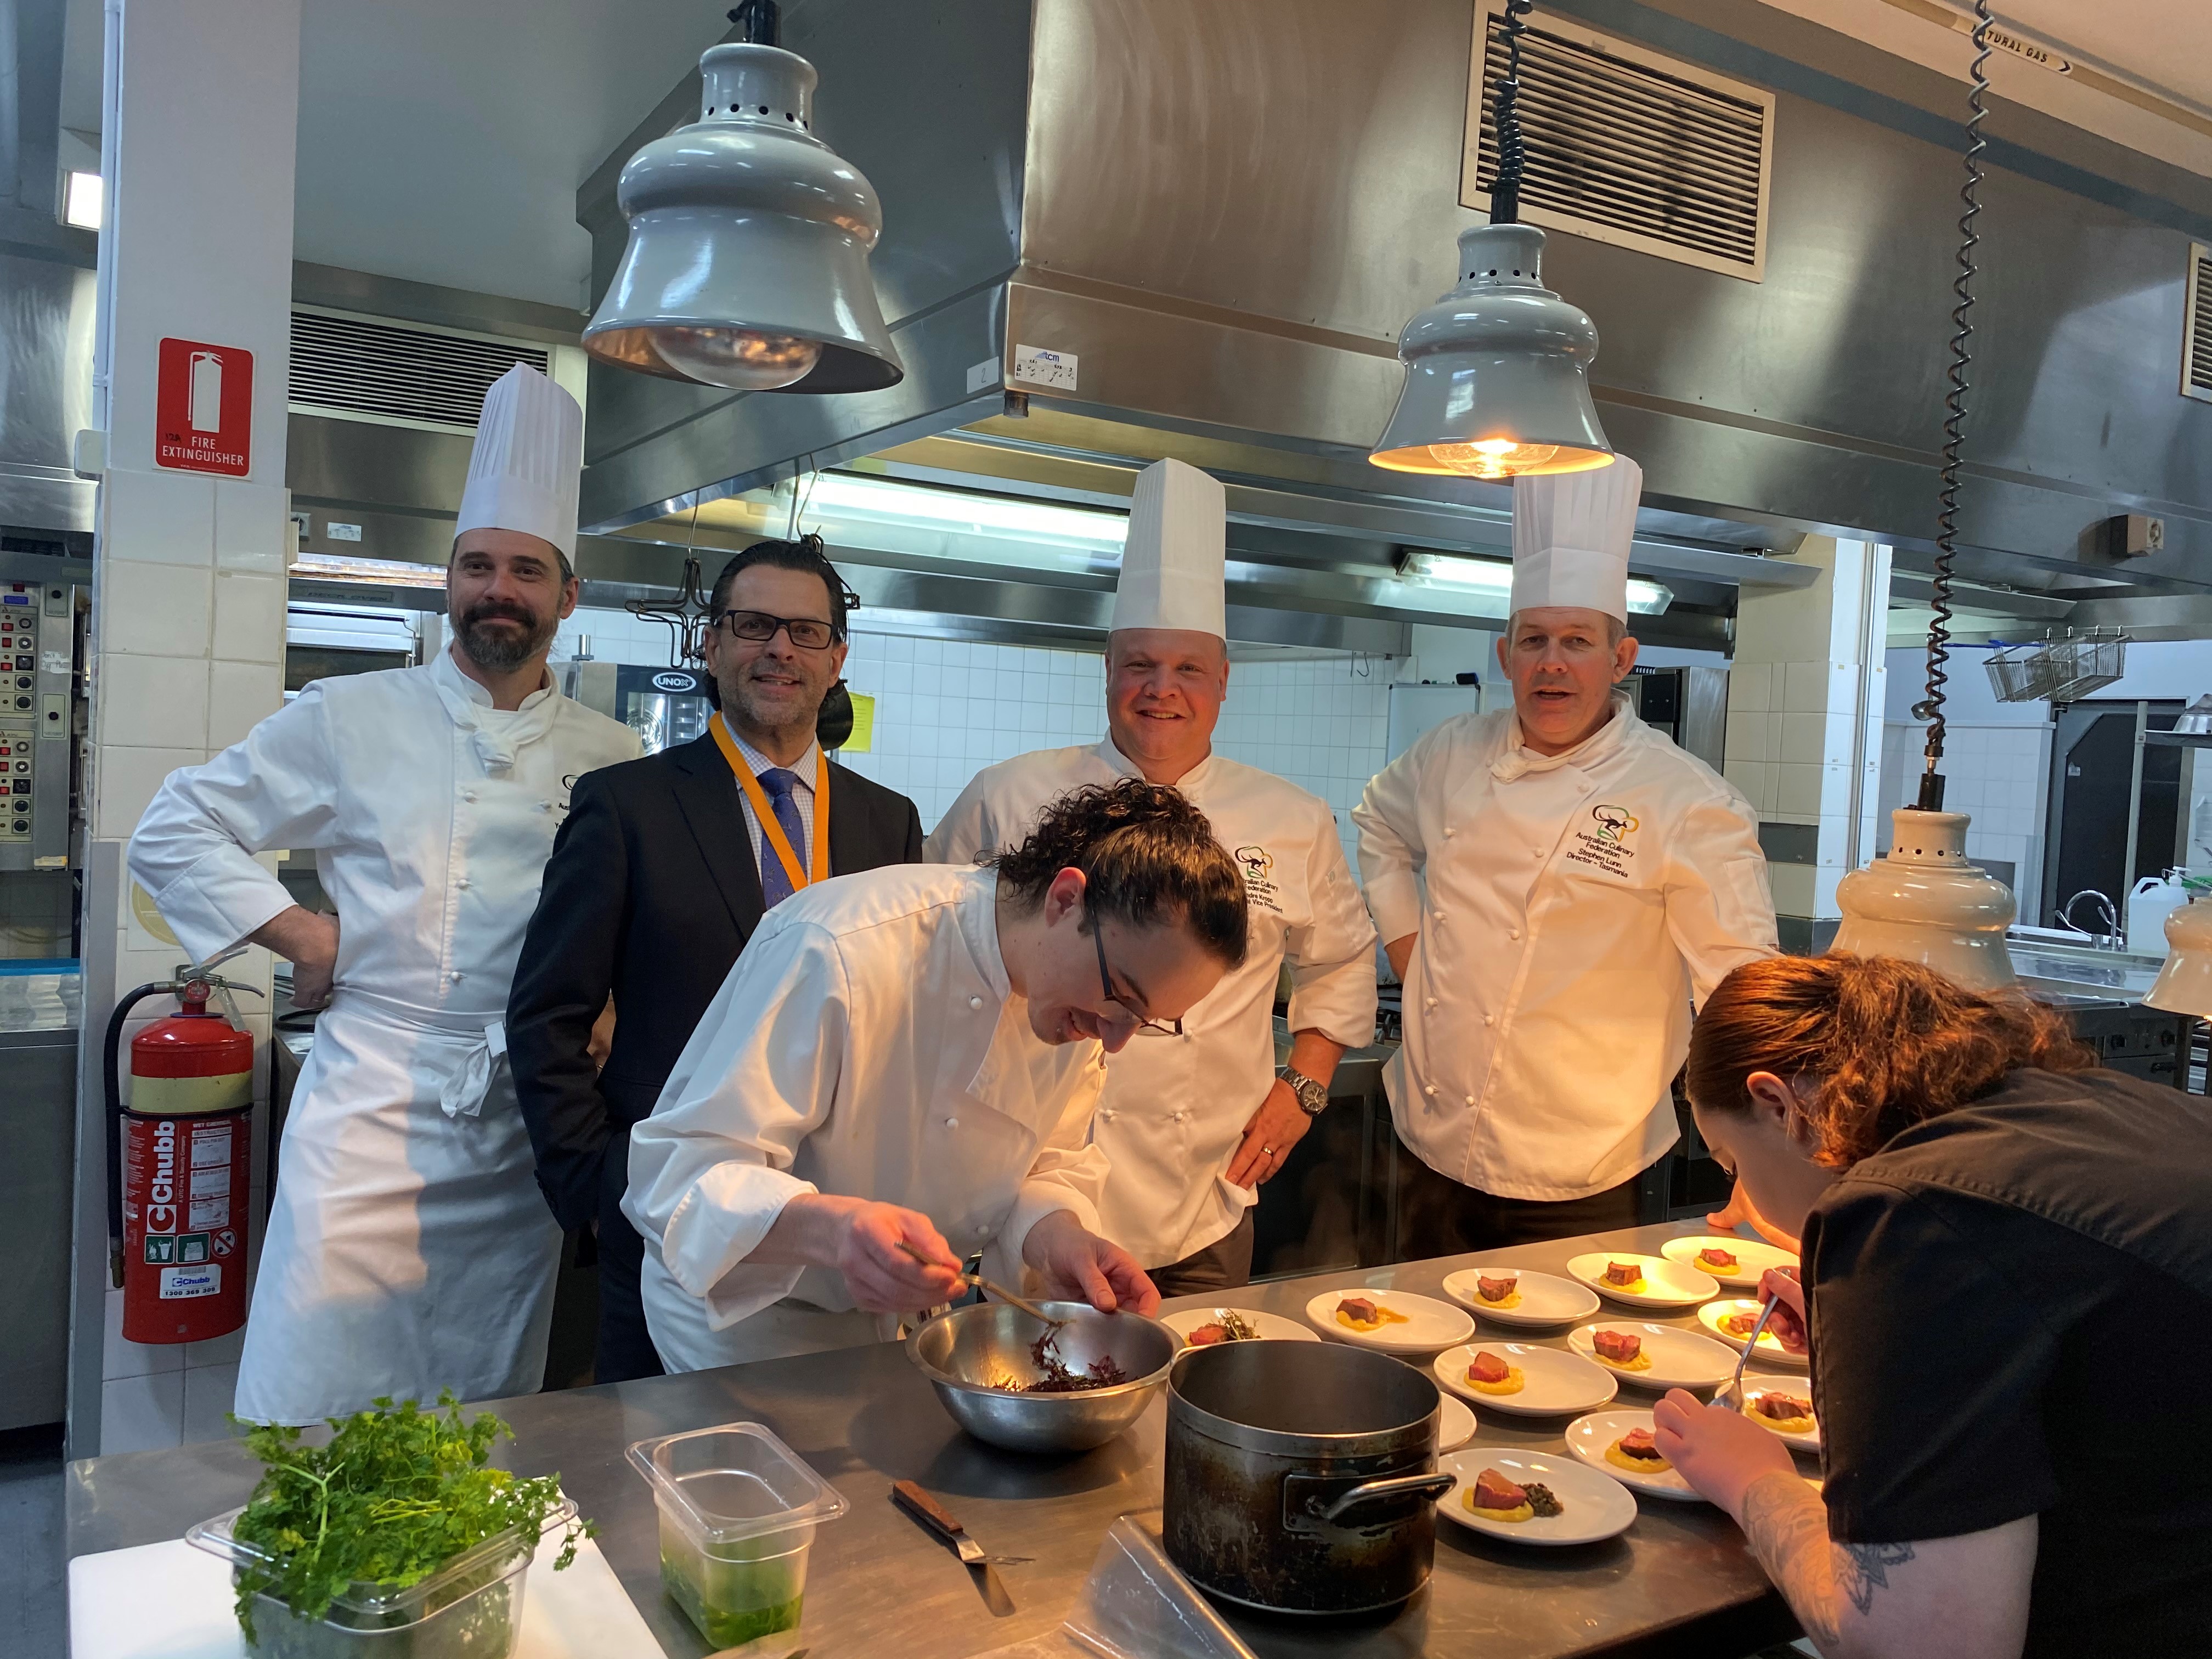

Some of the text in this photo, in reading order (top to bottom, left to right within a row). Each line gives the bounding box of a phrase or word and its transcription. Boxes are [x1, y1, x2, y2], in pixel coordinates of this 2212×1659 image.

[2026, 47, 2048, 63] GAS
[192, 436, 216, 449] FIRE
[162, 445, 244, 466] EXTINGUISHER
[658, 677, 689, 686] UNOX
[1576, 832, 1635, 857] Australian Culinary
[1585, 842, 1621, 859] Federation
[1566, 851, 1593, 864] Director
[1599, 862, 1628, 878] Tasmania
[1578, 848, 1622, 868] Stephen Lunn
[1261, 881, 1278, 892] Culinary
[1259, 894, 1273, 904] Kropp
[1264, 901, 1283, 913] President
[151, 1121, 176, 1204] Chubb
[183, 1277, 211, 1285] Chubb
